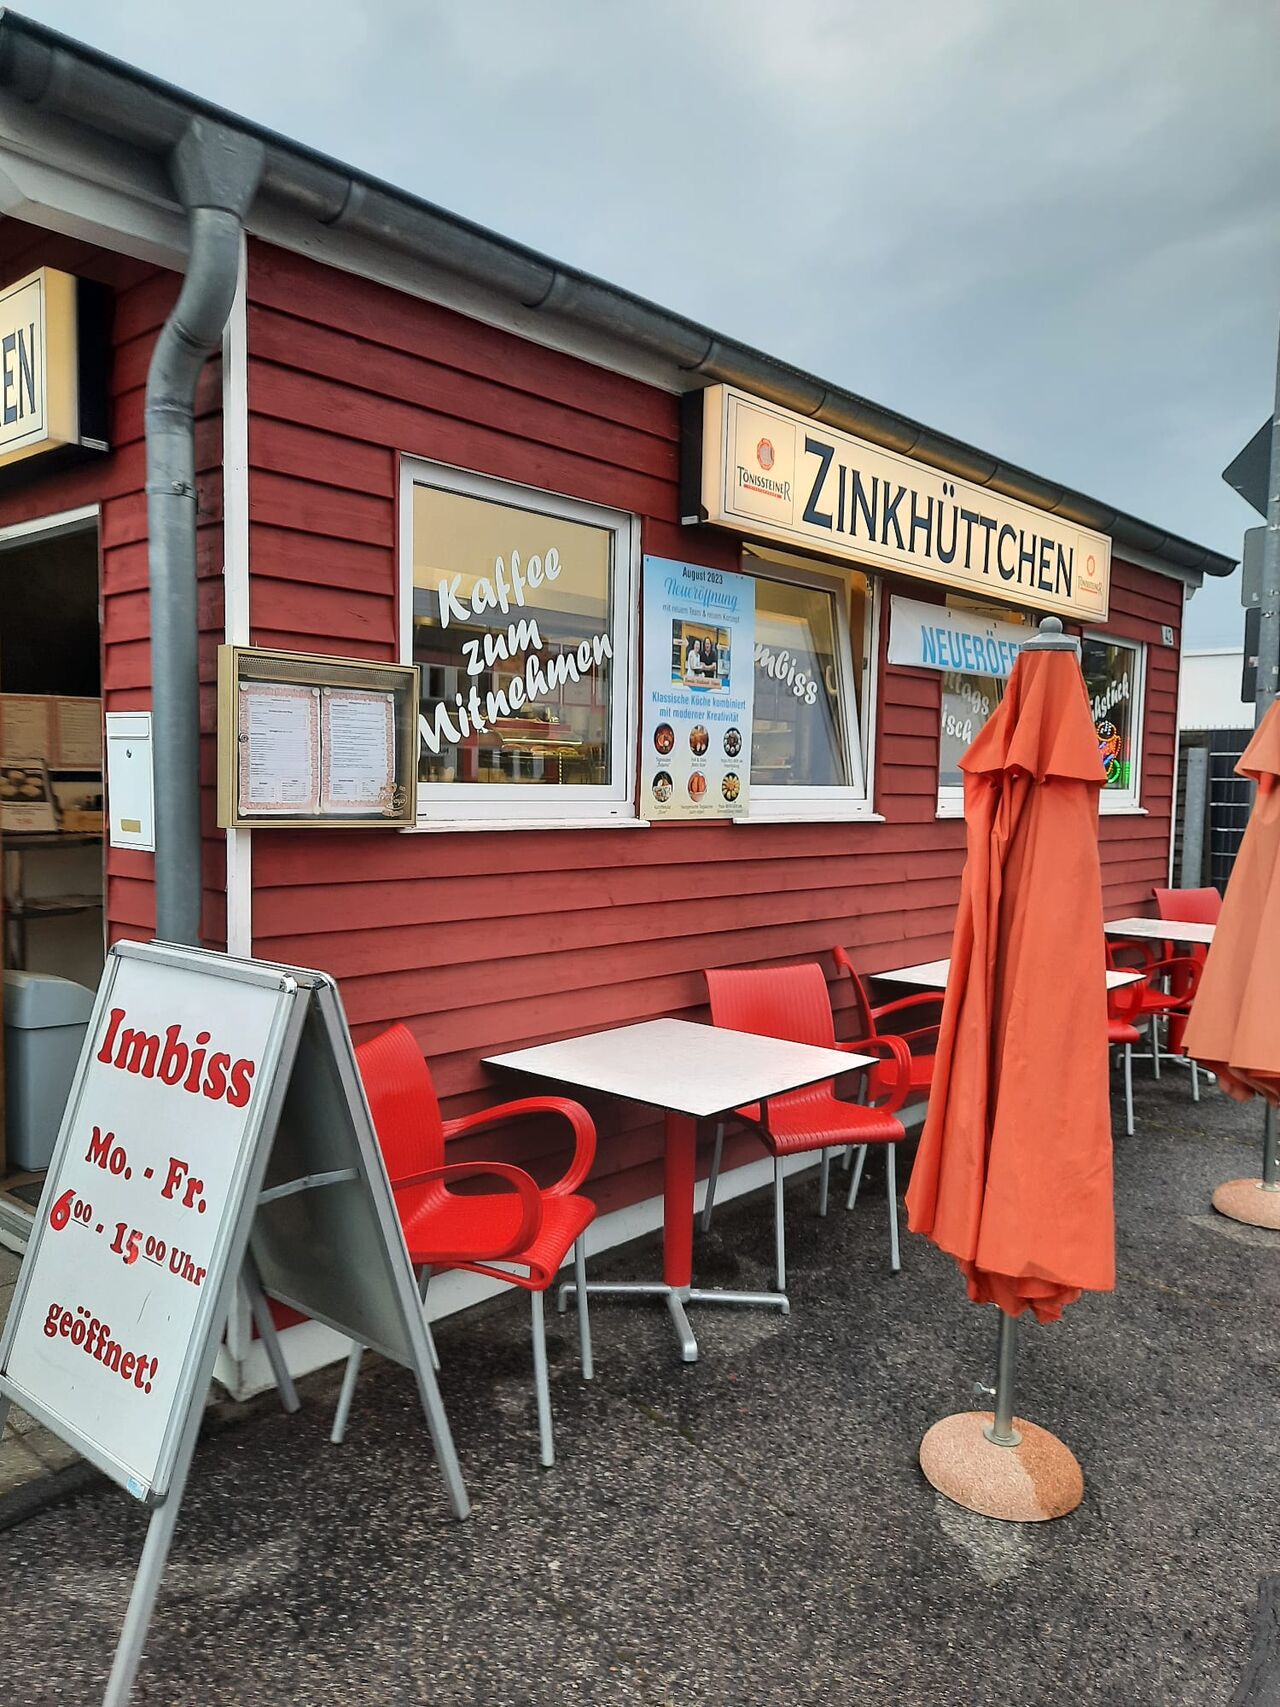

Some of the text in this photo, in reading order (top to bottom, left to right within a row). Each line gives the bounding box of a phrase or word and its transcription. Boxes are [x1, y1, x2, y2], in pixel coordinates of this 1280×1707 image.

[1, 323, 36, 426] EN
[737, 466, 791, 502] TÖNISSTEINER
[802, 433, 1074, 599] ZINKHÜTTCHEN
[438, 547, 562, 630] Kaffee
[664, 577, 738, 612] Neueröffnung
[682, 566, 724, 585] August 2023
[462, 618, 543, 676] zum
[753, 642, 818, 705] mbiss
[921, 625, 1022, 675] NEUERÖFF
[418, 633, 613, 755] Mitnehmen
[652, 691, 746, 710] Klassische Küche kombiniert
[659, 707, 739, 722] mit moderner Kreativität
[942, 704, 973, 745] isch
[97, 1007, 256, 1109] Imbiss
[84, 1126, 132, 1181] Mo.
[160, 1156, 207, 1214] Fr.
[168, 1246, 207, 1286] Uhr
[43, 1302, 159, 1395] geöffnet!
